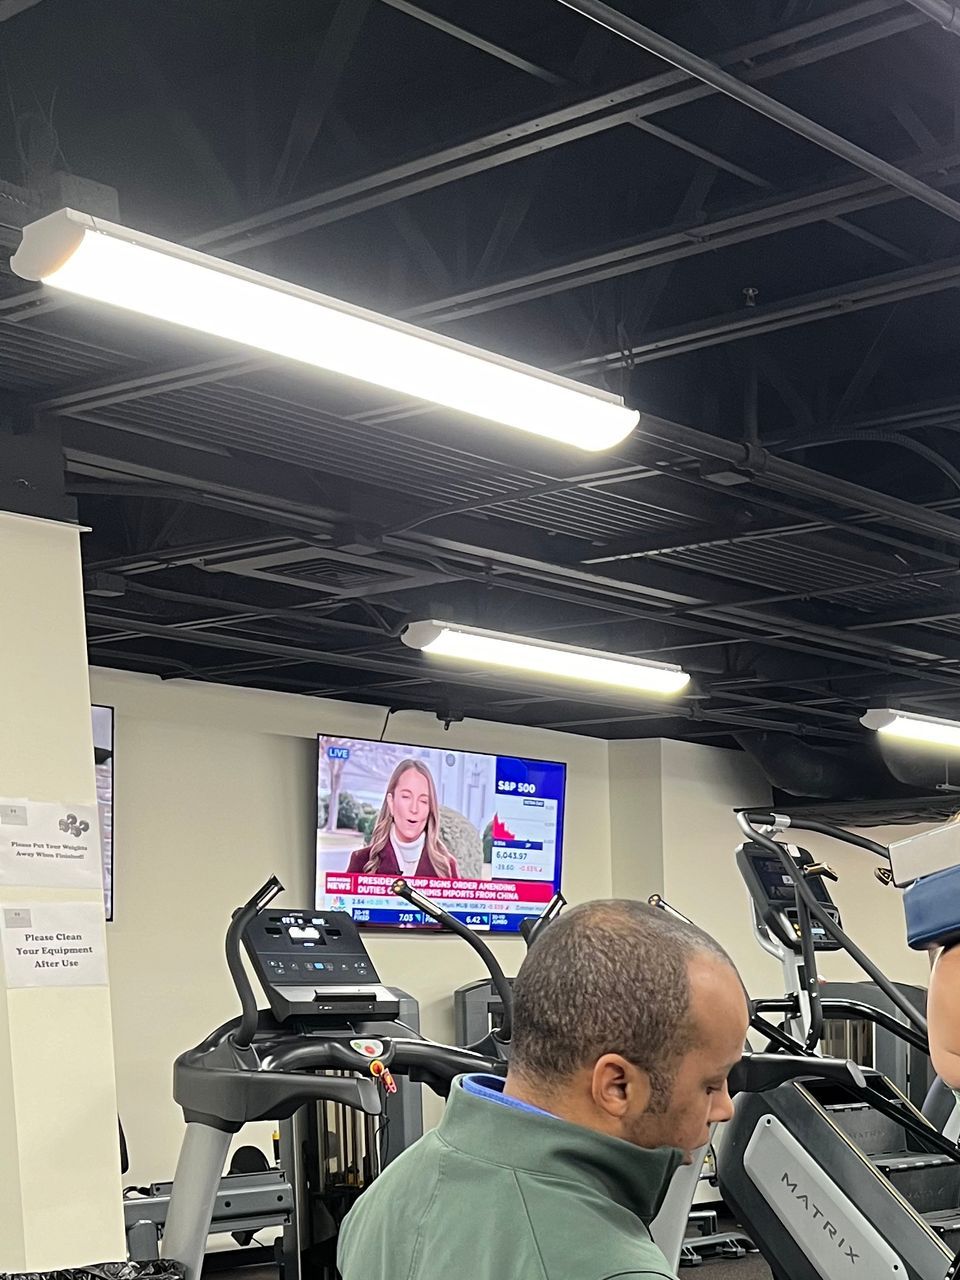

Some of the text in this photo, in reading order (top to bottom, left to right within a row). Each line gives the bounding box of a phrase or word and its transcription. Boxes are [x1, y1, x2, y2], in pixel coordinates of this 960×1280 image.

[329, 748, 348, 758] LIVE
[498, 780, 536, 794] S&P 500
[327, 882, 351, 891] NEWS
[429, 880, 451, 888] SIGNS
[452, 881, 478, 890] ORDER
[479, 882, 516, 891] AMENDING
[358, 886, 386, 894] DUTIES
[442, 889, 475, 898] IMPORTS
[475, 891, 496, 899] FROM
[497, 892, 519, 900] CHINA
[399, 913, 413, 922] 7.03
[466, 916, 481, 924] 6.42
[25, 933, 82, 942] Please Clean
[16, 946, 93, 956] Your Equipment
[34, 959, 79, 968] After Use
[781, 1172, 860, 1264] MATRIX
